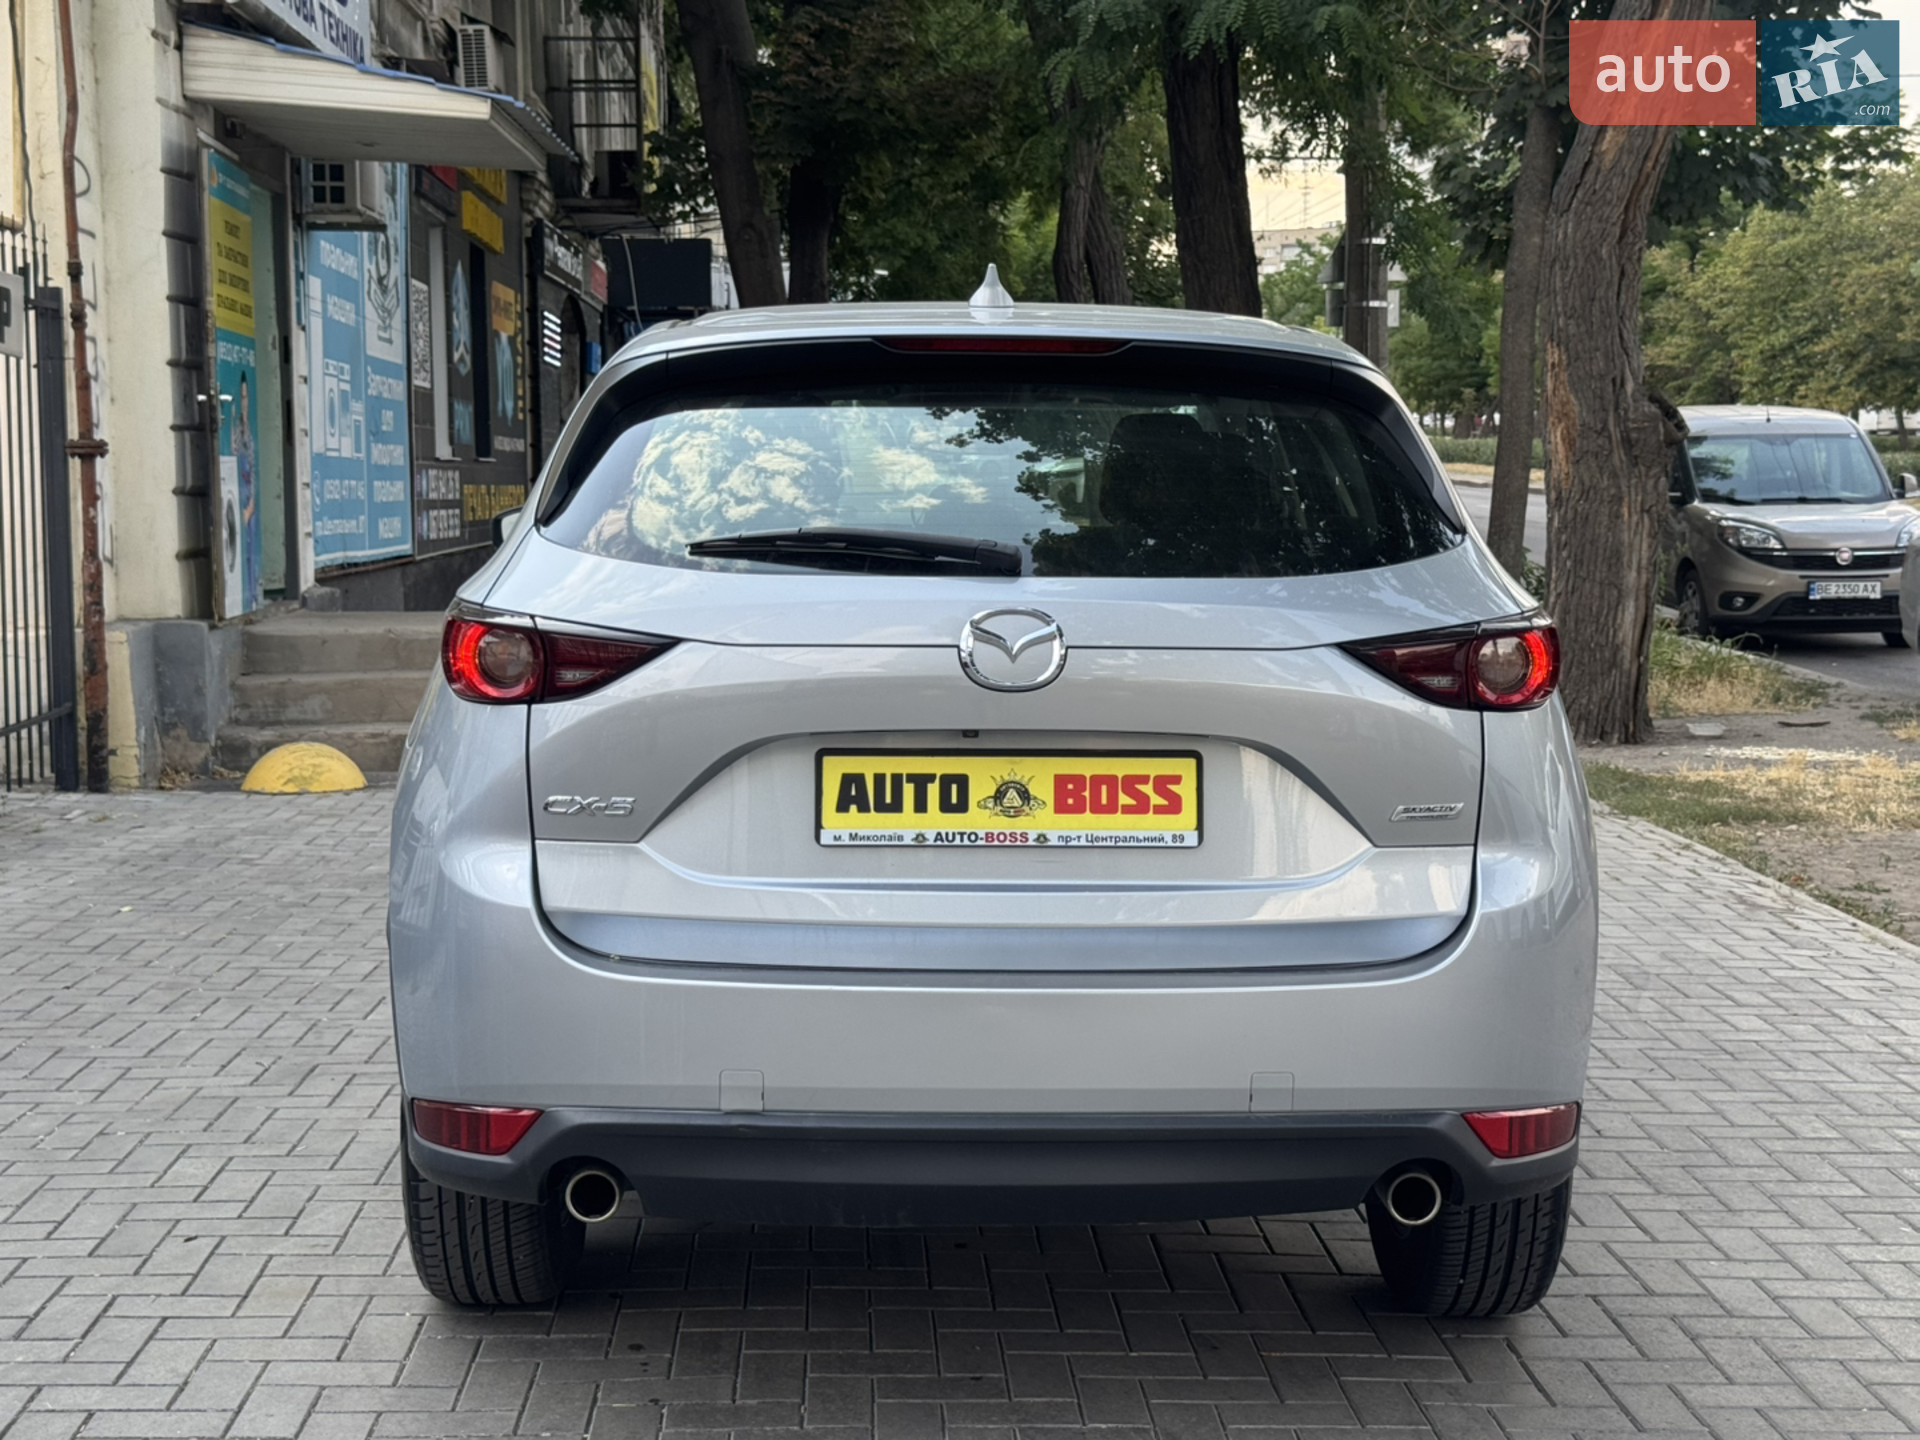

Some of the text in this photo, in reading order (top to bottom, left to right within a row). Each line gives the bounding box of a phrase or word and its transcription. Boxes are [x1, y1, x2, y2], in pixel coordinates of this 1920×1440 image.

[320, 2, 365, 65] ТЕХНІКА
[835, 772, 1184, 816] AUTO BOSS
[543, 795, 636, 817] CX-5
[1401, 805, 1457, 814] SKYACTIV
[833, 831, 1185, 846] м. Миколаїв AUTO-BOSS пр-т Центральний, 89
